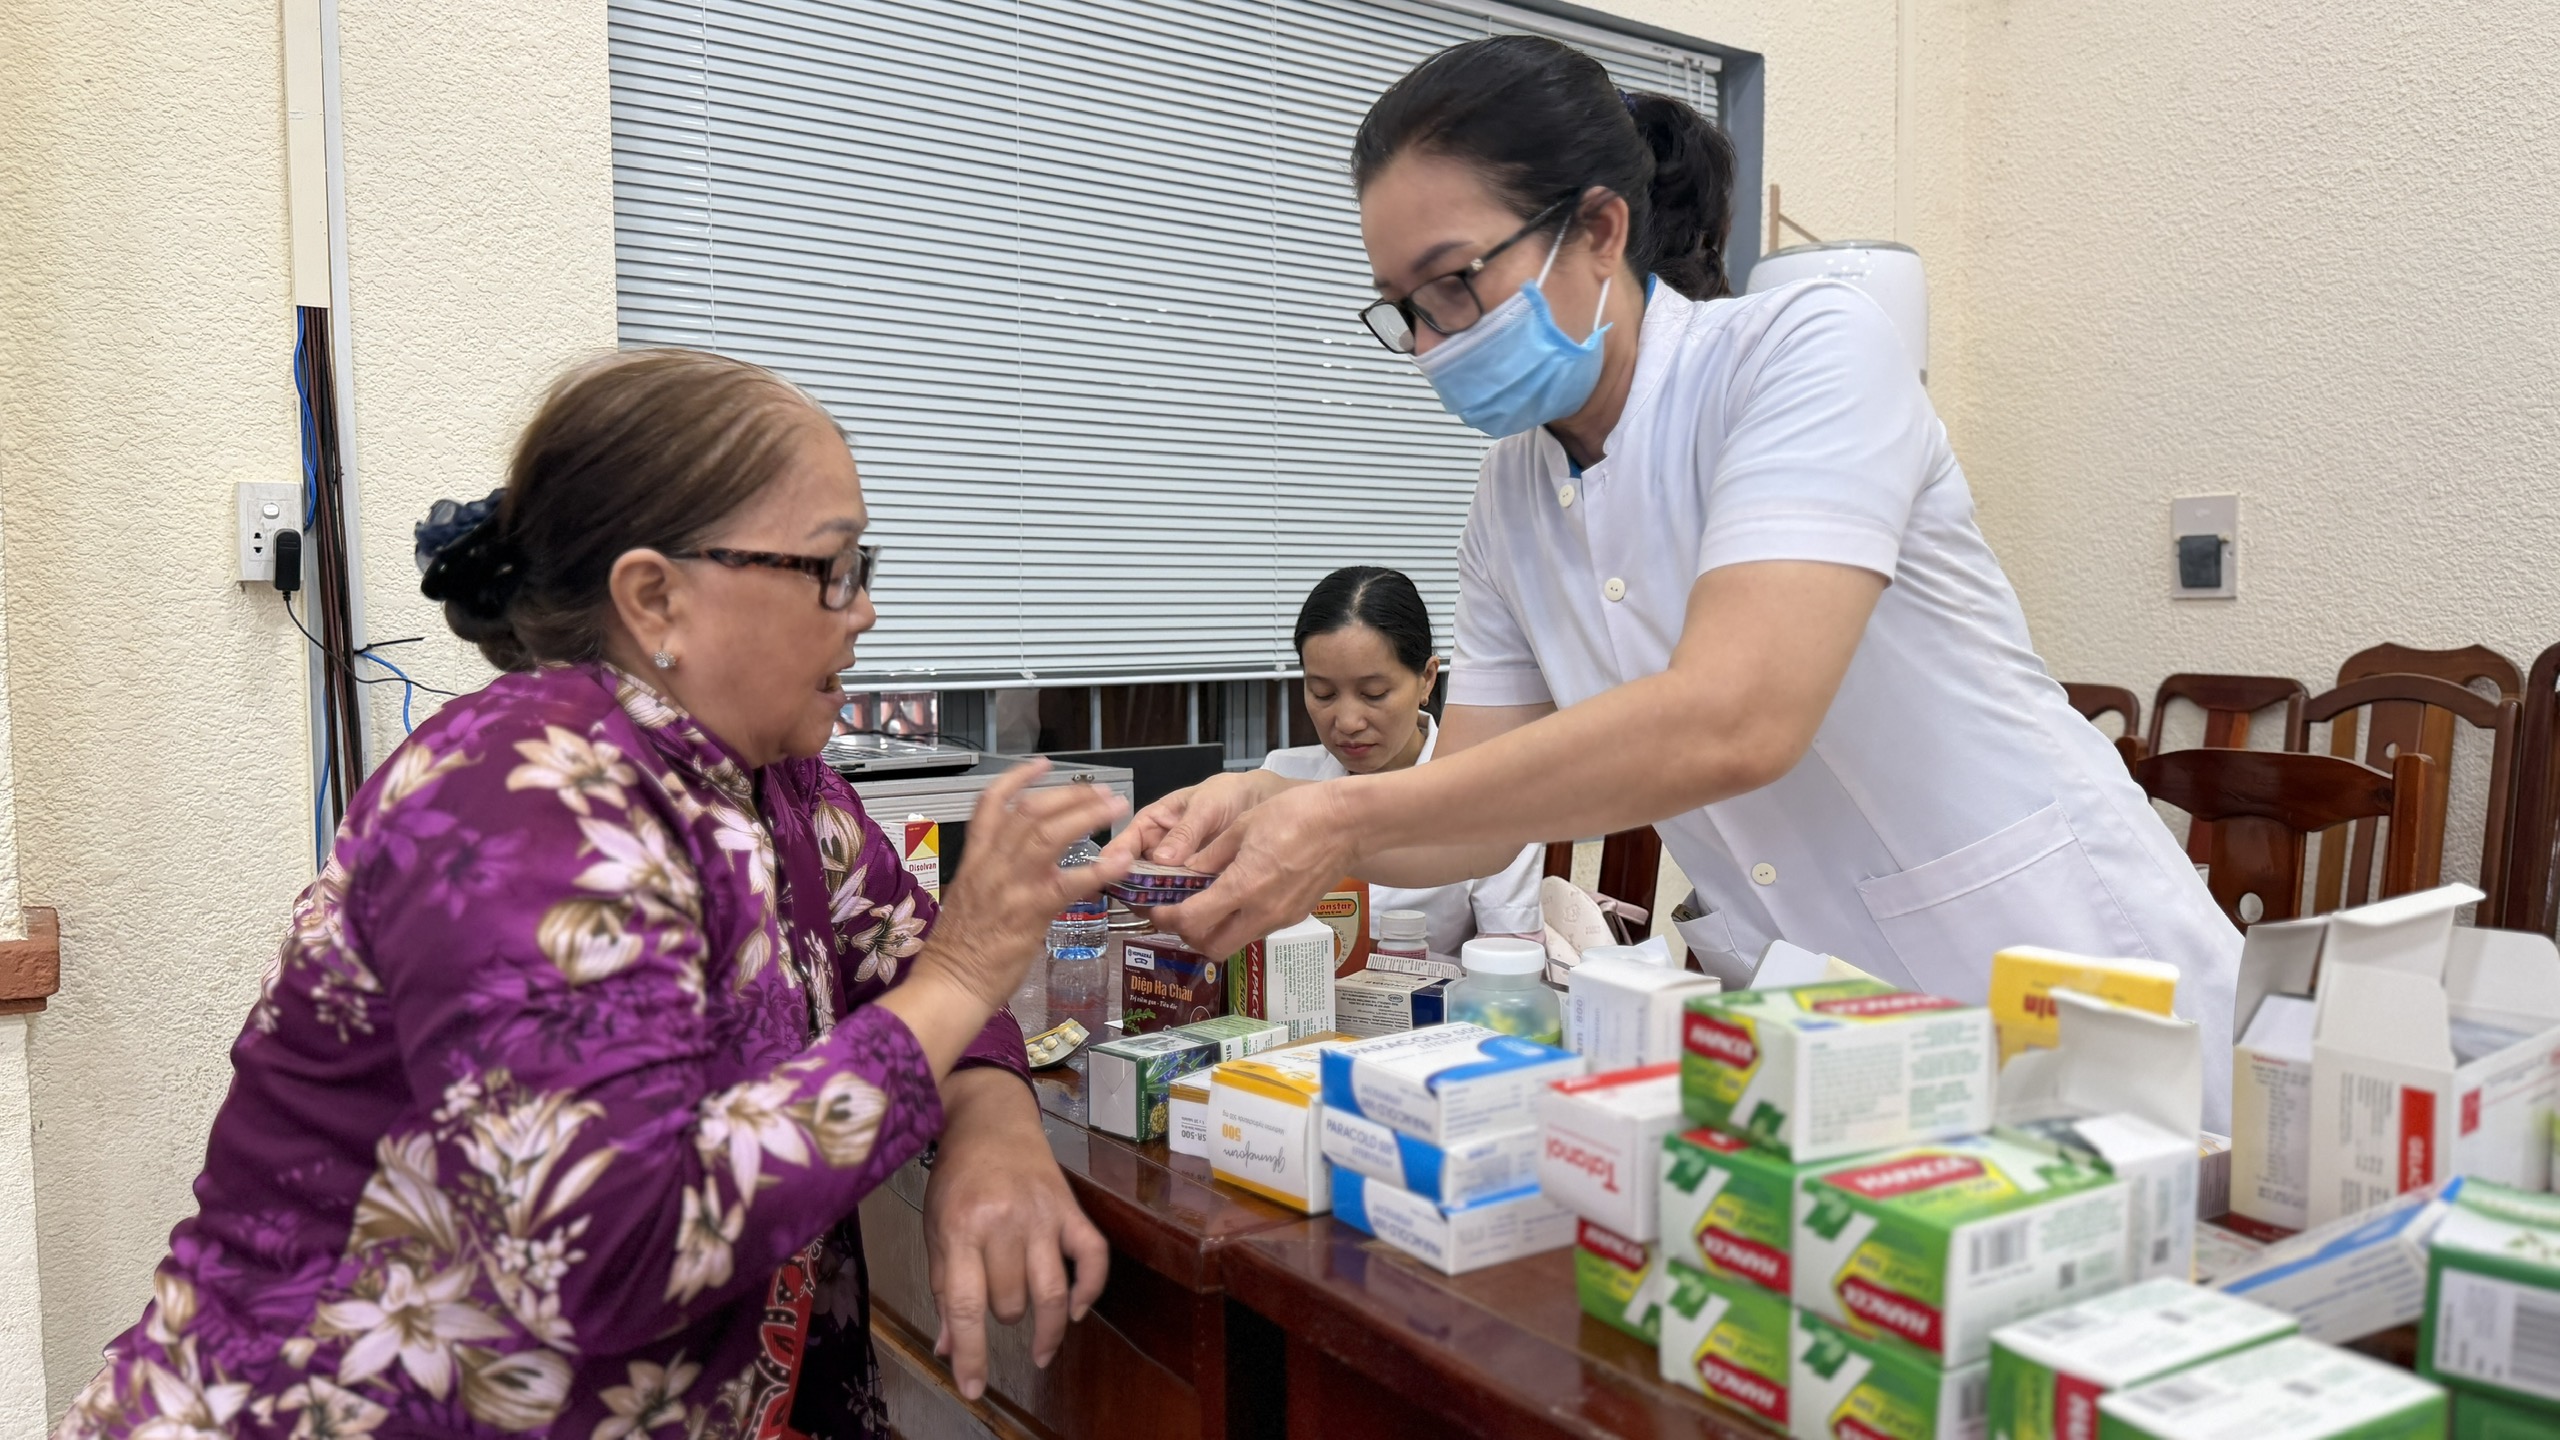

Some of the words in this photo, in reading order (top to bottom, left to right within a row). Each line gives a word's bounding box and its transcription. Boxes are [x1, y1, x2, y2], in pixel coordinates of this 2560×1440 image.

[909, 862, 937, 872] Disolvan
[1131, 974, 1153, 995] Diệp
[1154, 979, 1167, 999] Hạ
[1169, 982, 1193, 1002] Châu
[1350, 1030, 1452, 1055] PARACOLD
[1221, 1123, 1242, 1142] 500
[1326, 1118, 1377, 1149] PARACOLD
